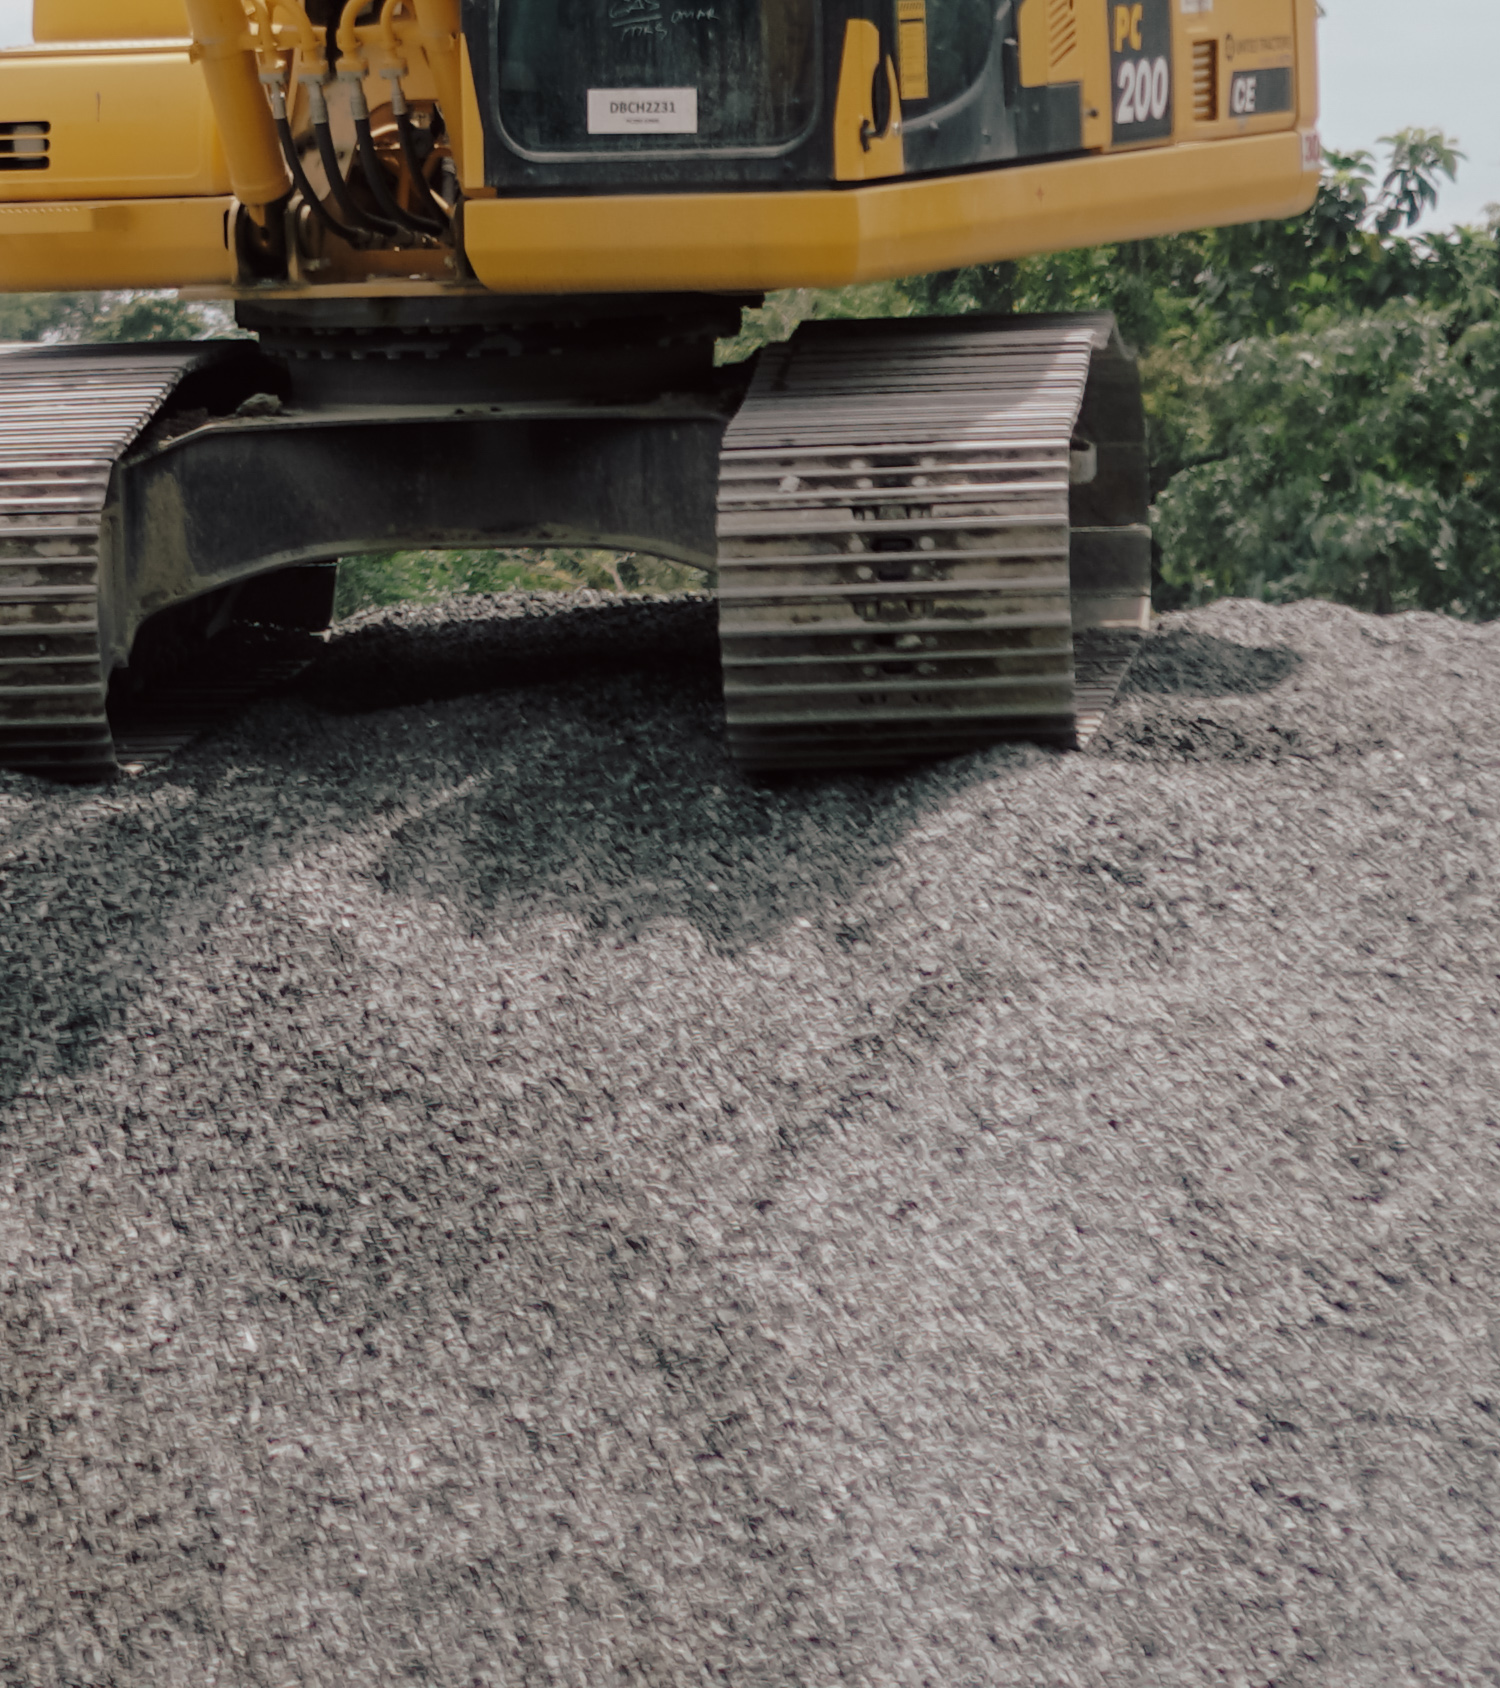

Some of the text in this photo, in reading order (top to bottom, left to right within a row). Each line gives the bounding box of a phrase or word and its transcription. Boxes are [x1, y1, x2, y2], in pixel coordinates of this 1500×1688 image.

[1113, 2, 1143, 53] PC
[1115, 55, 1169, 124] 200
[1231, 76, 1256, 114] CE
